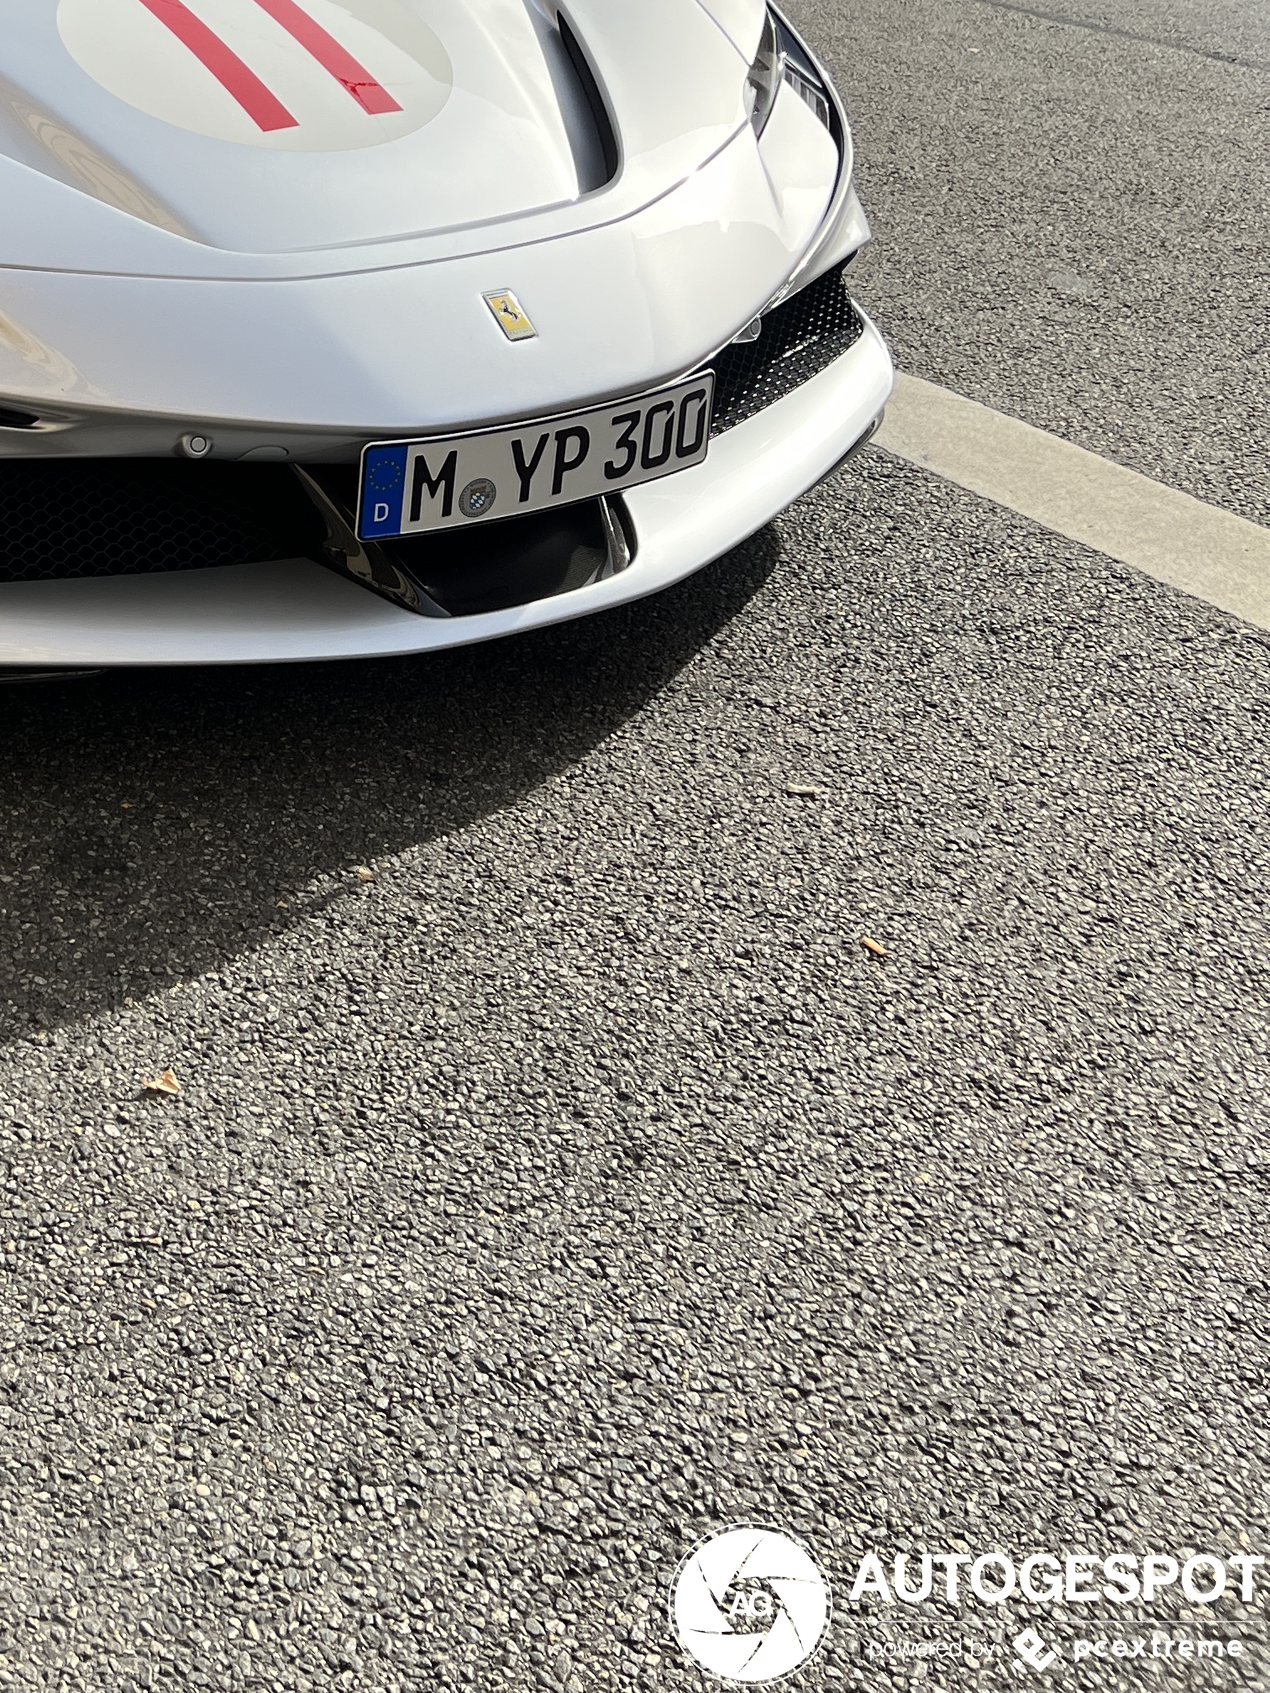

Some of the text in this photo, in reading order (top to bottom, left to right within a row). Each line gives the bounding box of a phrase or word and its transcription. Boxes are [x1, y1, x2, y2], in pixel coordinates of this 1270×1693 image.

[374, 503, 389, 522] D
[409, 449, 458, 522] M
[510, 425, 590, 503] YP
[604, 387, 708, 480] 300
